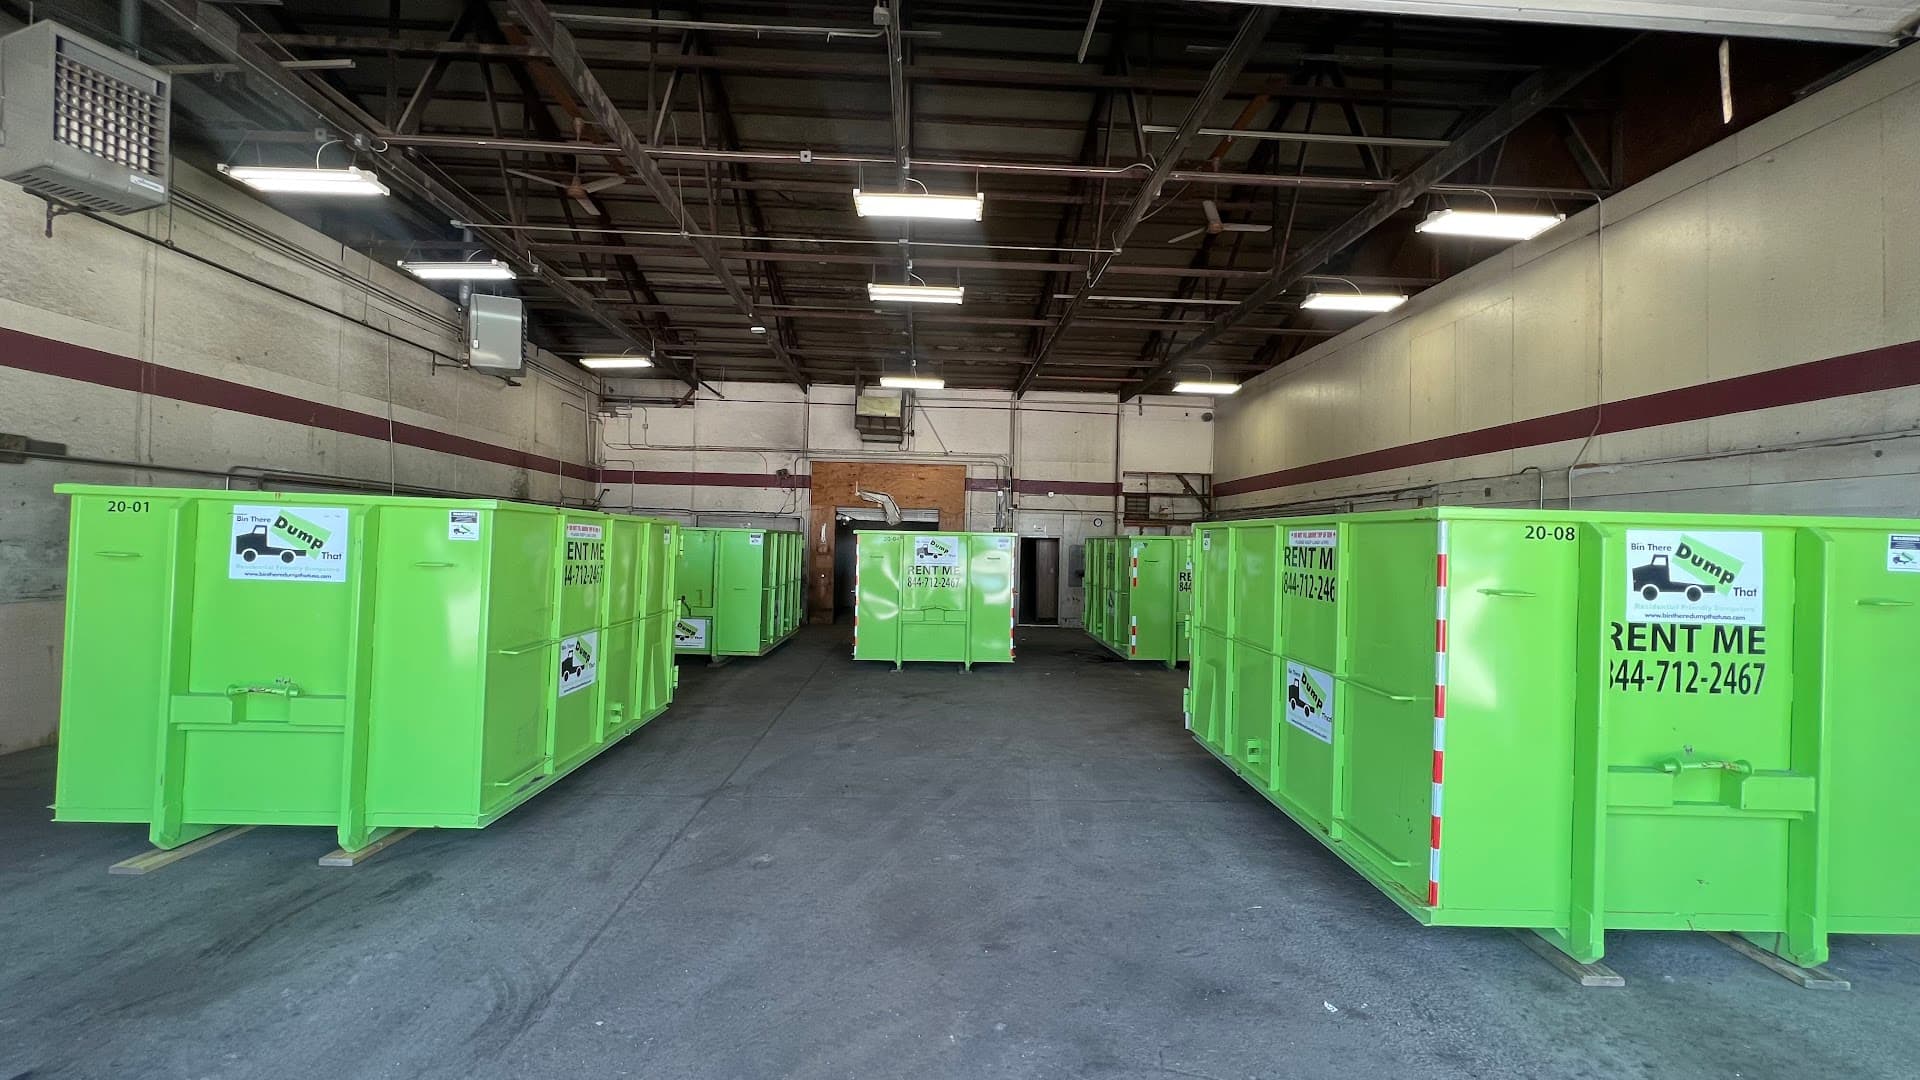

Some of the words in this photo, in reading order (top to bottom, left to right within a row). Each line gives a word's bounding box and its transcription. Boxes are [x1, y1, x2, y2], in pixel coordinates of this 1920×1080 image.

[108, 501, 150, 513] 20-01
[236, 515, 249, 523] Bin
[250, 515, 272, 524] There
[274, 515, 324, 550] Dump
[1524, 525, 1576, 541] 20-08
[590, 542, 604, 561] ME
[930, 539, 949, 554] Dump
[1630, 543, 1645, 551] Bin
[1647, 543, 1672, 552] There
[321, 551, 342, 561] That
[1284, 546, 1317, 569] RENT
[1319, 547, 1336, 571] M
[1675, 542, 1735, 585] Dump
[907, 565, 939, 576] RENT
[942, 565, 961, 576] ME
[907, 577, 960, 588] 844-712-2467
[1733, 586, 1758, 597] That
[677, 622, 696, 636] Dump
[1610, 621, 1702, 652] RENT
[1712, 624, 1766, 654] ME
[575, 640, 590, 664] Dump
[1301, 672, 1323, 709] Dump
